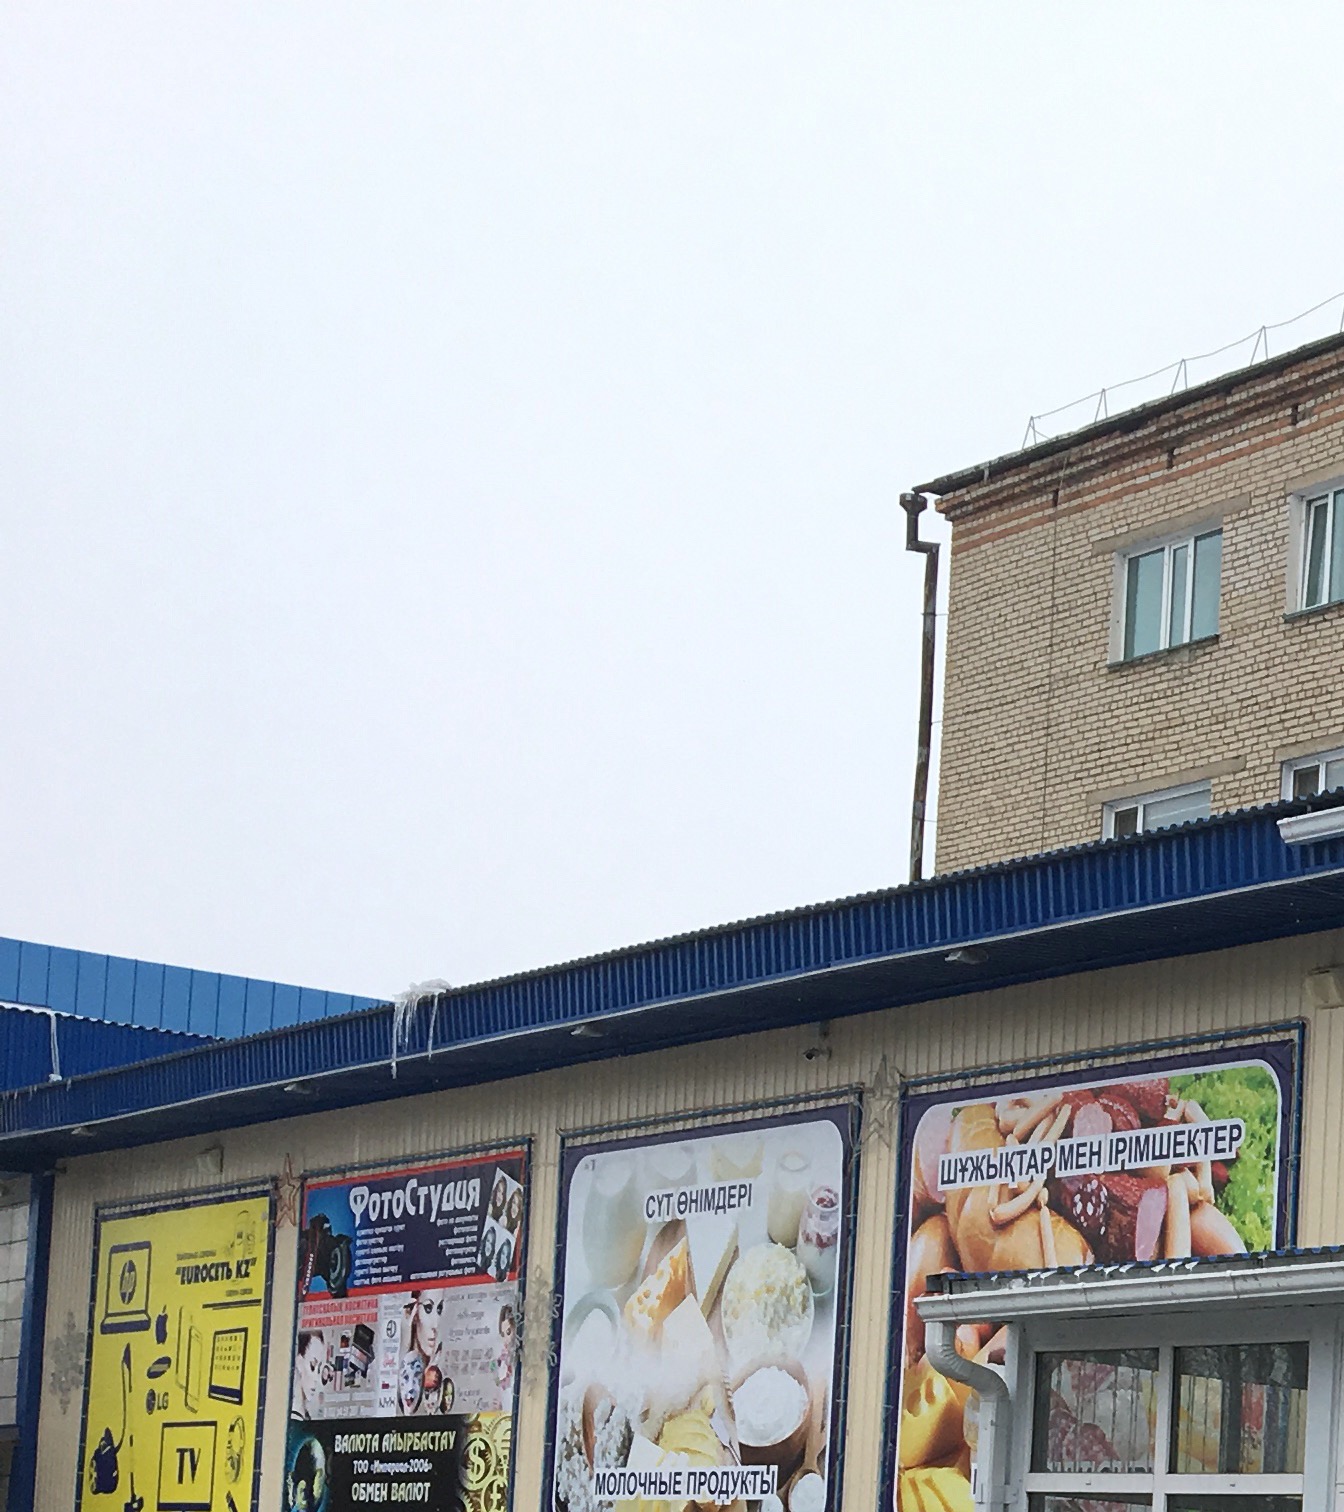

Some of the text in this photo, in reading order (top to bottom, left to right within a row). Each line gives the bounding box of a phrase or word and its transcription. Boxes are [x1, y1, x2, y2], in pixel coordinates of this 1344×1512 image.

[940, 1123, 1243, 1186] ШҰЖЫҚТАР МЕН ІРІМШЕКТЕР
[645, 1183, 753, 1219] СҮТ ӨНІМДЕРІ
[334, 1430, 457, 1454] ВАЛЮТА АЙЫРБАСТАУ
[176, 1448, 202, 1485] TV
[351, 1482, 431, 1503] ОБМЕН ВАЛЮТ
[595, 1470, 775, 1499] МОЛОЧНЫЕ ПРОДУКТЫ
